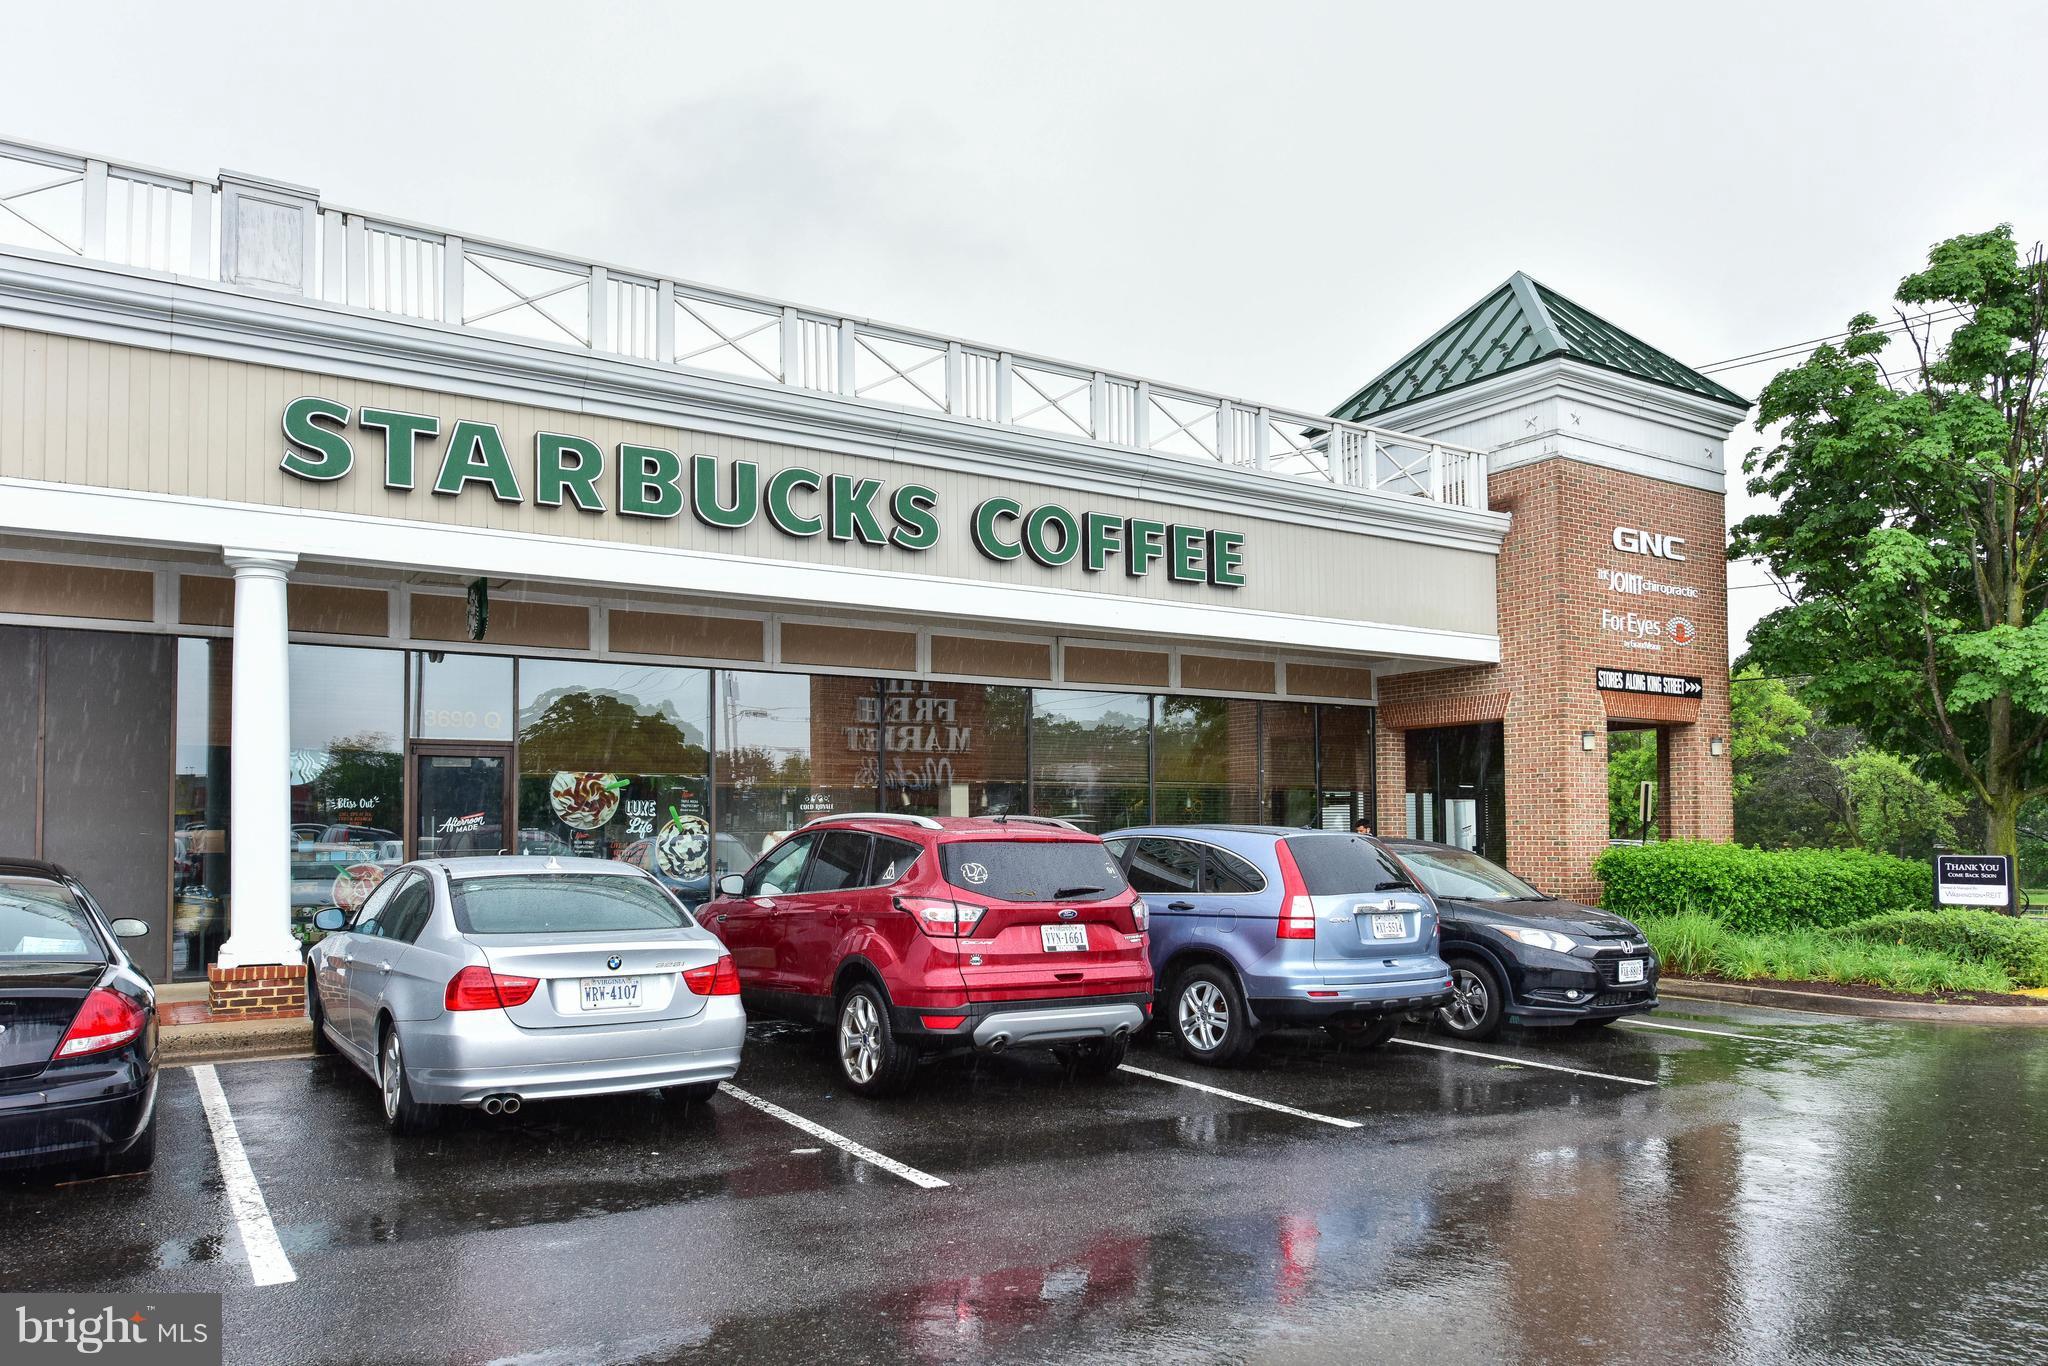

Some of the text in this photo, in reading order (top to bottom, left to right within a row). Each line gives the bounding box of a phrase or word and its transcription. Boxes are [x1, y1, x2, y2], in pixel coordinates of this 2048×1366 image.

[279, 395, 1247, 588] STARBUCKS COFFEE
[1612, 526, 1686, 562] GNC
[1609, 569, 1643, 596] JOINT
[1642, 580, 1699, 599] chiropractic
[1602, 608, 1661, 639] For Eyes
[1598, 670, 1685, 695] STORES ALONG KING STREET
[424, 709, 477, 729] 3690
[337, 797, 375, 809] Bliss Out
[625, 800, 657, 817] LUXE
[437, 815, 486, 833] Afternoon
[456, 824, 479, 834] MADE
[626, 817, 654, 839] Life
[1945, 863, 2000, 872] THANK YOU
[584, 985, 638, 1003] WRW-4107
